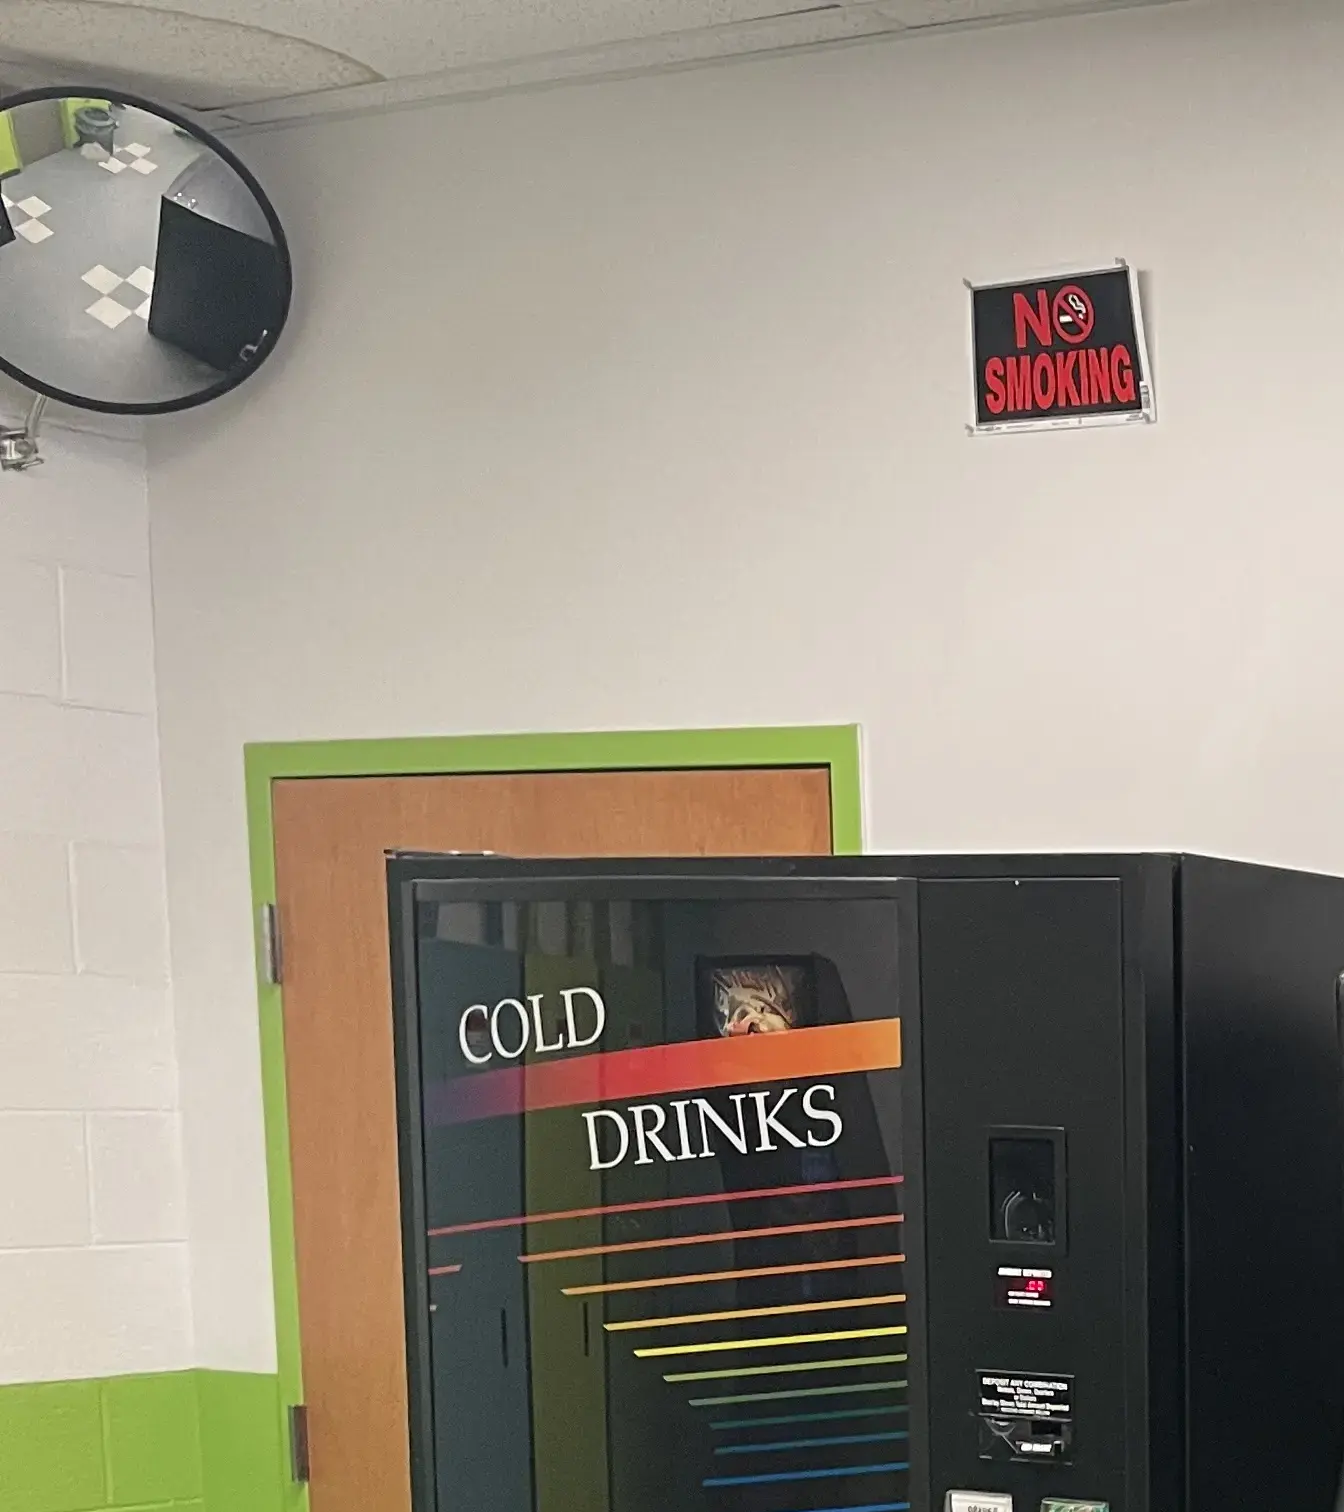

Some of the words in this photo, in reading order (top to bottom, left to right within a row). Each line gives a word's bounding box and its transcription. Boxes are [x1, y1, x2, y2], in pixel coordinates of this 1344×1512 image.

[985, 344, 1136, 414] SMOKING
[459, 986, 606, 1064] COLD
[581, 1084, 843, 1170] DRINKS
